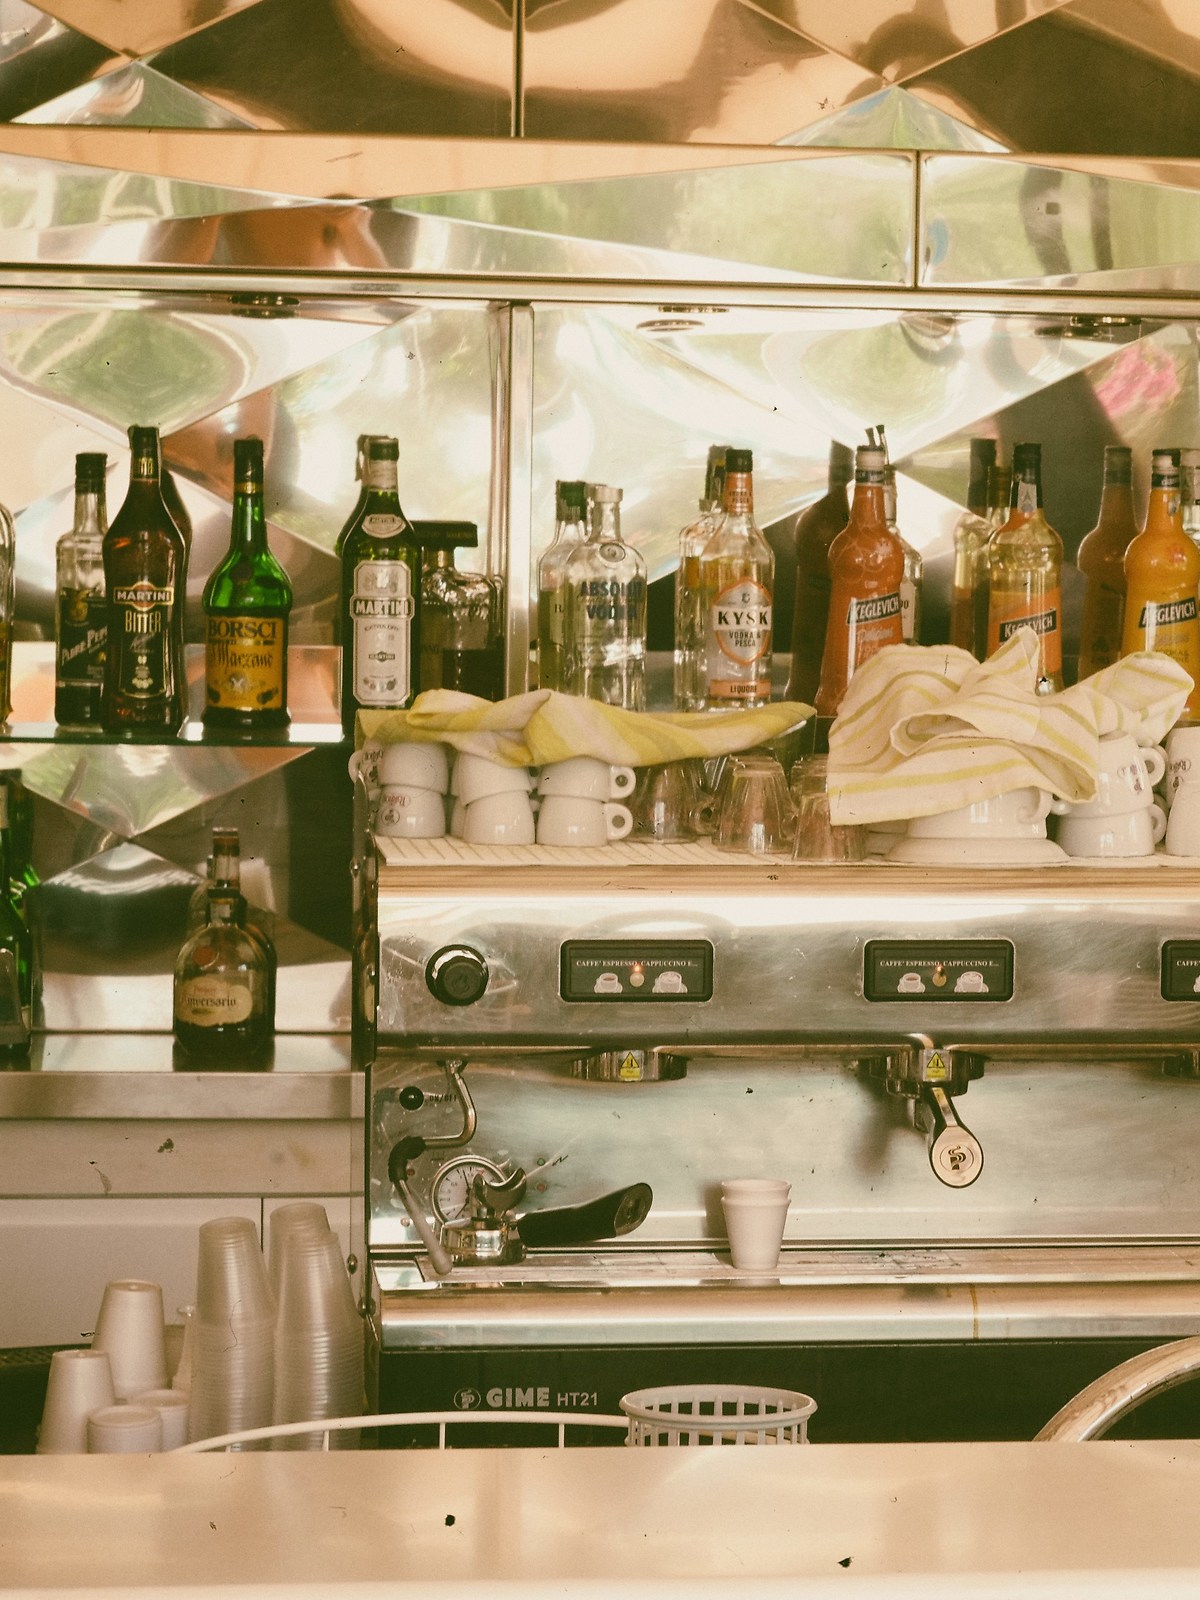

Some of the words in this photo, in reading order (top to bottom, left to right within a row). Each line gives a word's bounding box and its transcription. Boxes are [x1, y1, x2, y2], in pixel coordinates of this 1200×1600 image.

[117, 591, 170, 602] MARTINI
[355, 599, 410, 616] MARTINI
[125, 610, 162, 633] BITTER
[718, 611, 768, 626] KYSK
[208, 620, 277, 639] BORSCI
[729, 631, 754, 639] VODKA
[735, 640, 756, 648] PESCA
[486, 1387, 550, 1408] GIME
[557, 1392, 598, 1407] HT21
